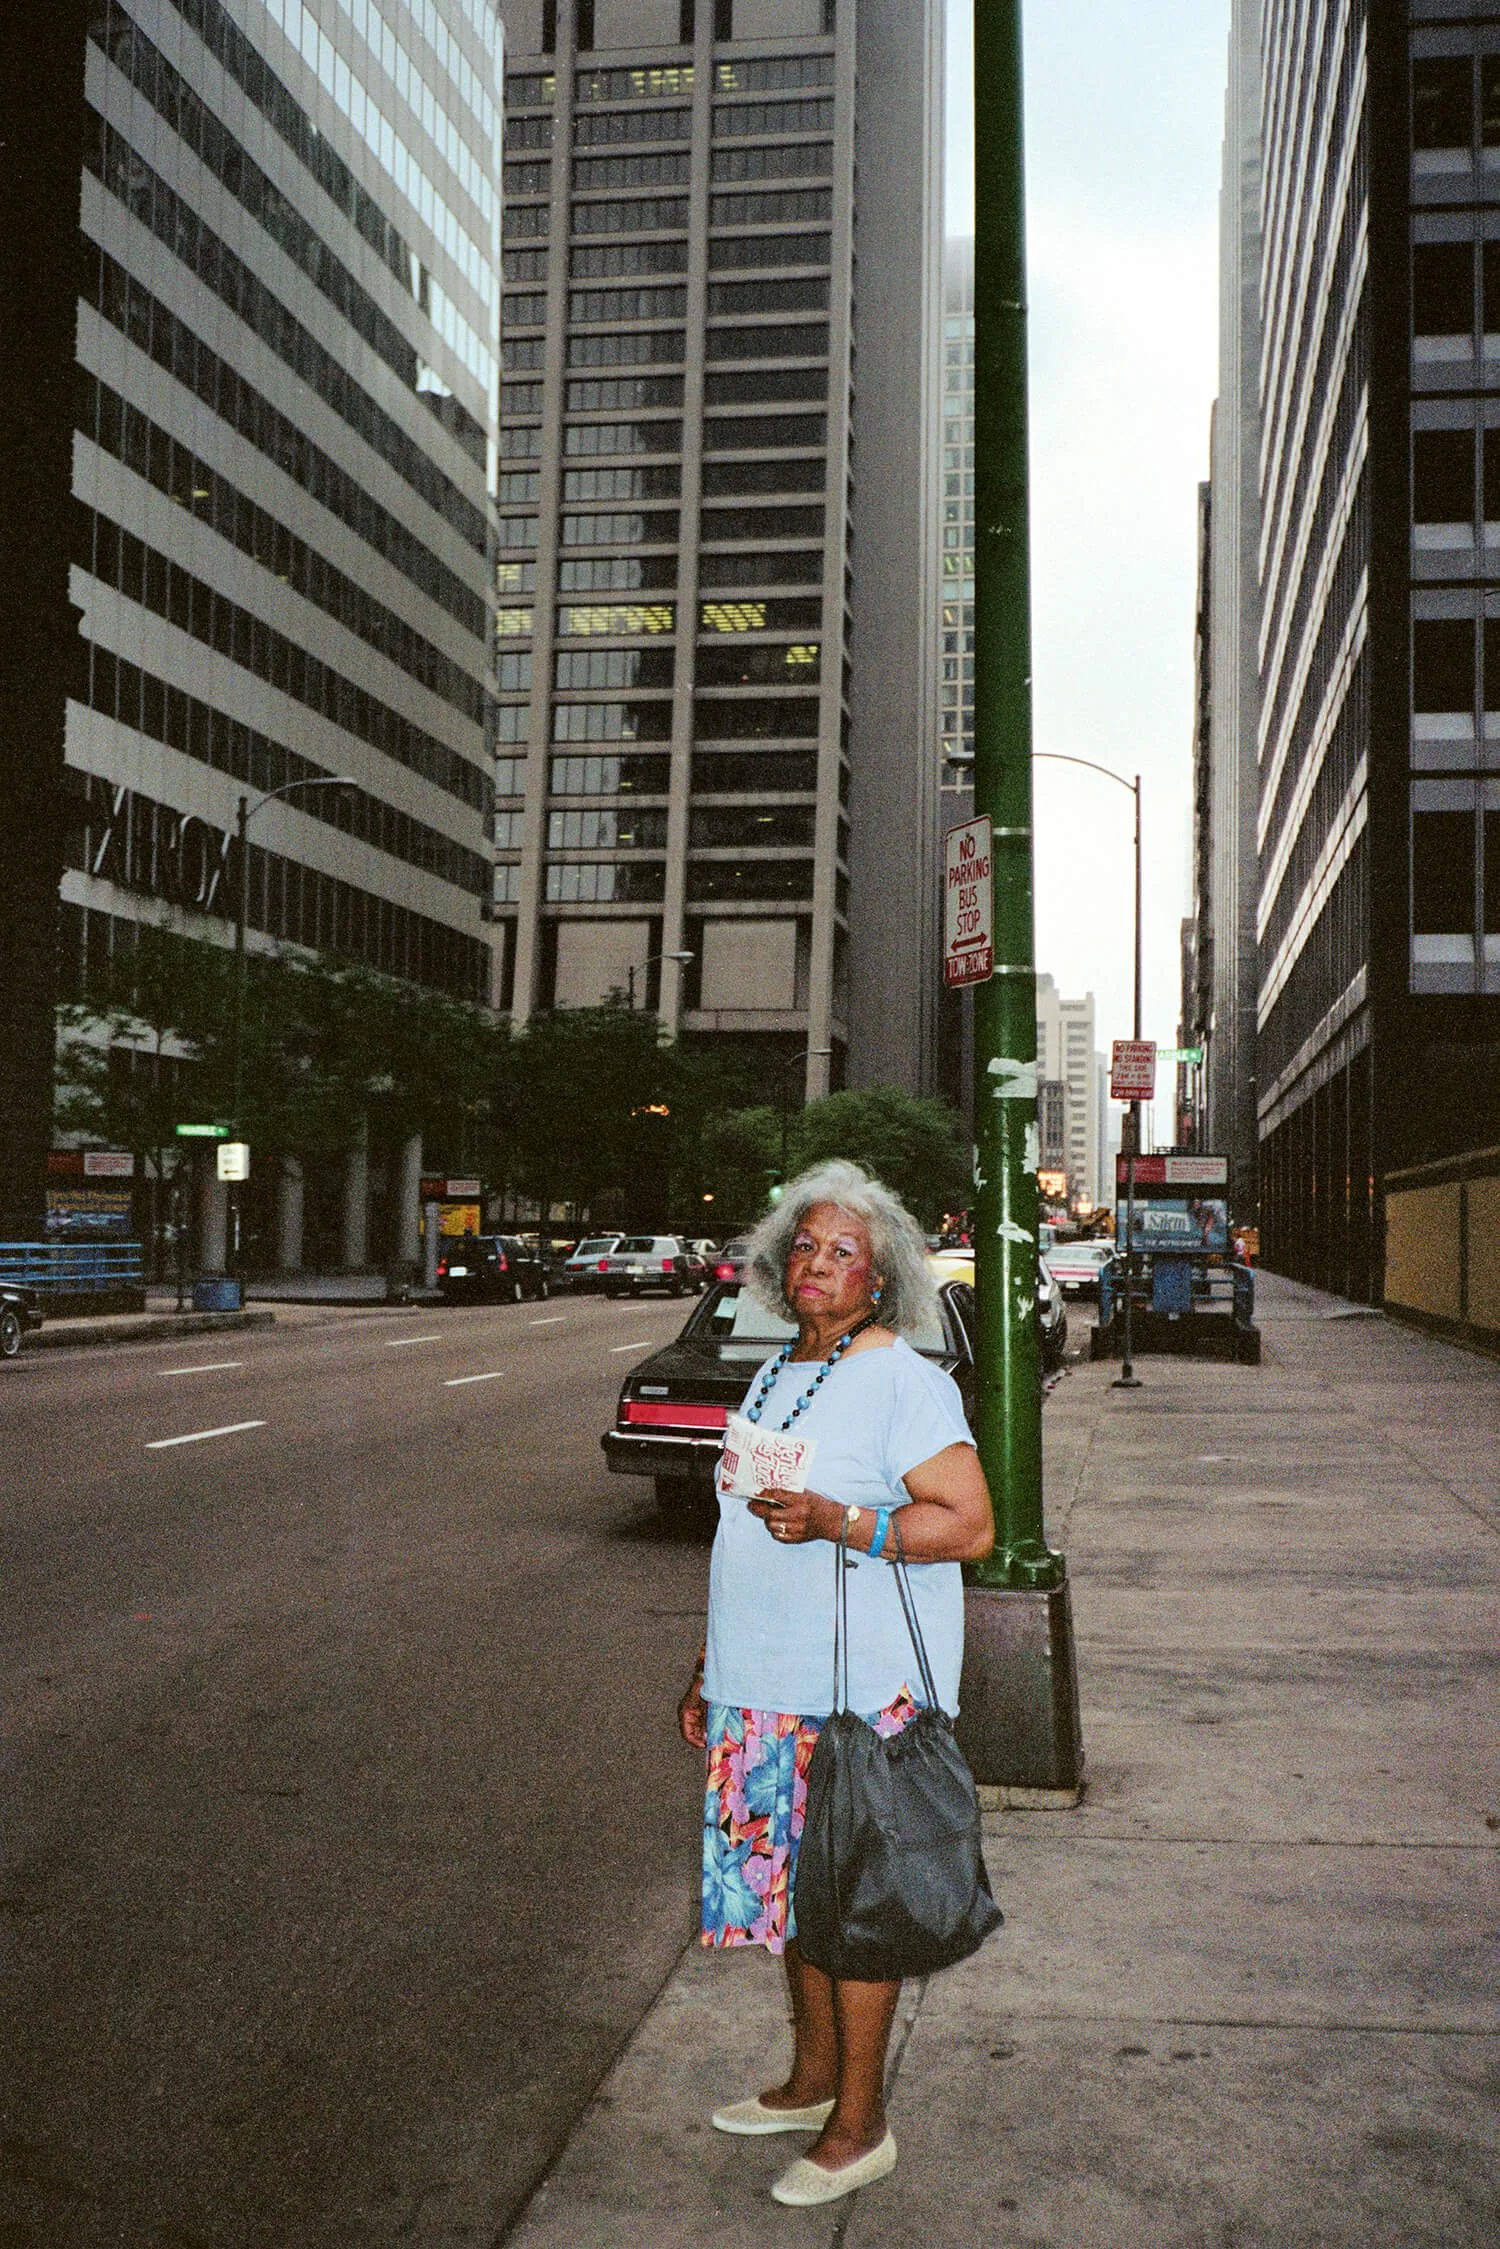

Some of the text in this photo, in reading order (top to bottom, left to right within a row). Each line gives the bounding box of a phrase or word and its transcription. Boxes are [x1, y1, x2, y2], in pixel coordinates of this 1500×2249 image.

[960, 836, 975, 861] NO
[949, 855, 989, 889] PARKING
[959, 885, 977, 910] BUS
[957, 909, 980, 935] STOP
[1127, 1044, 1152, 1053] PARKING
